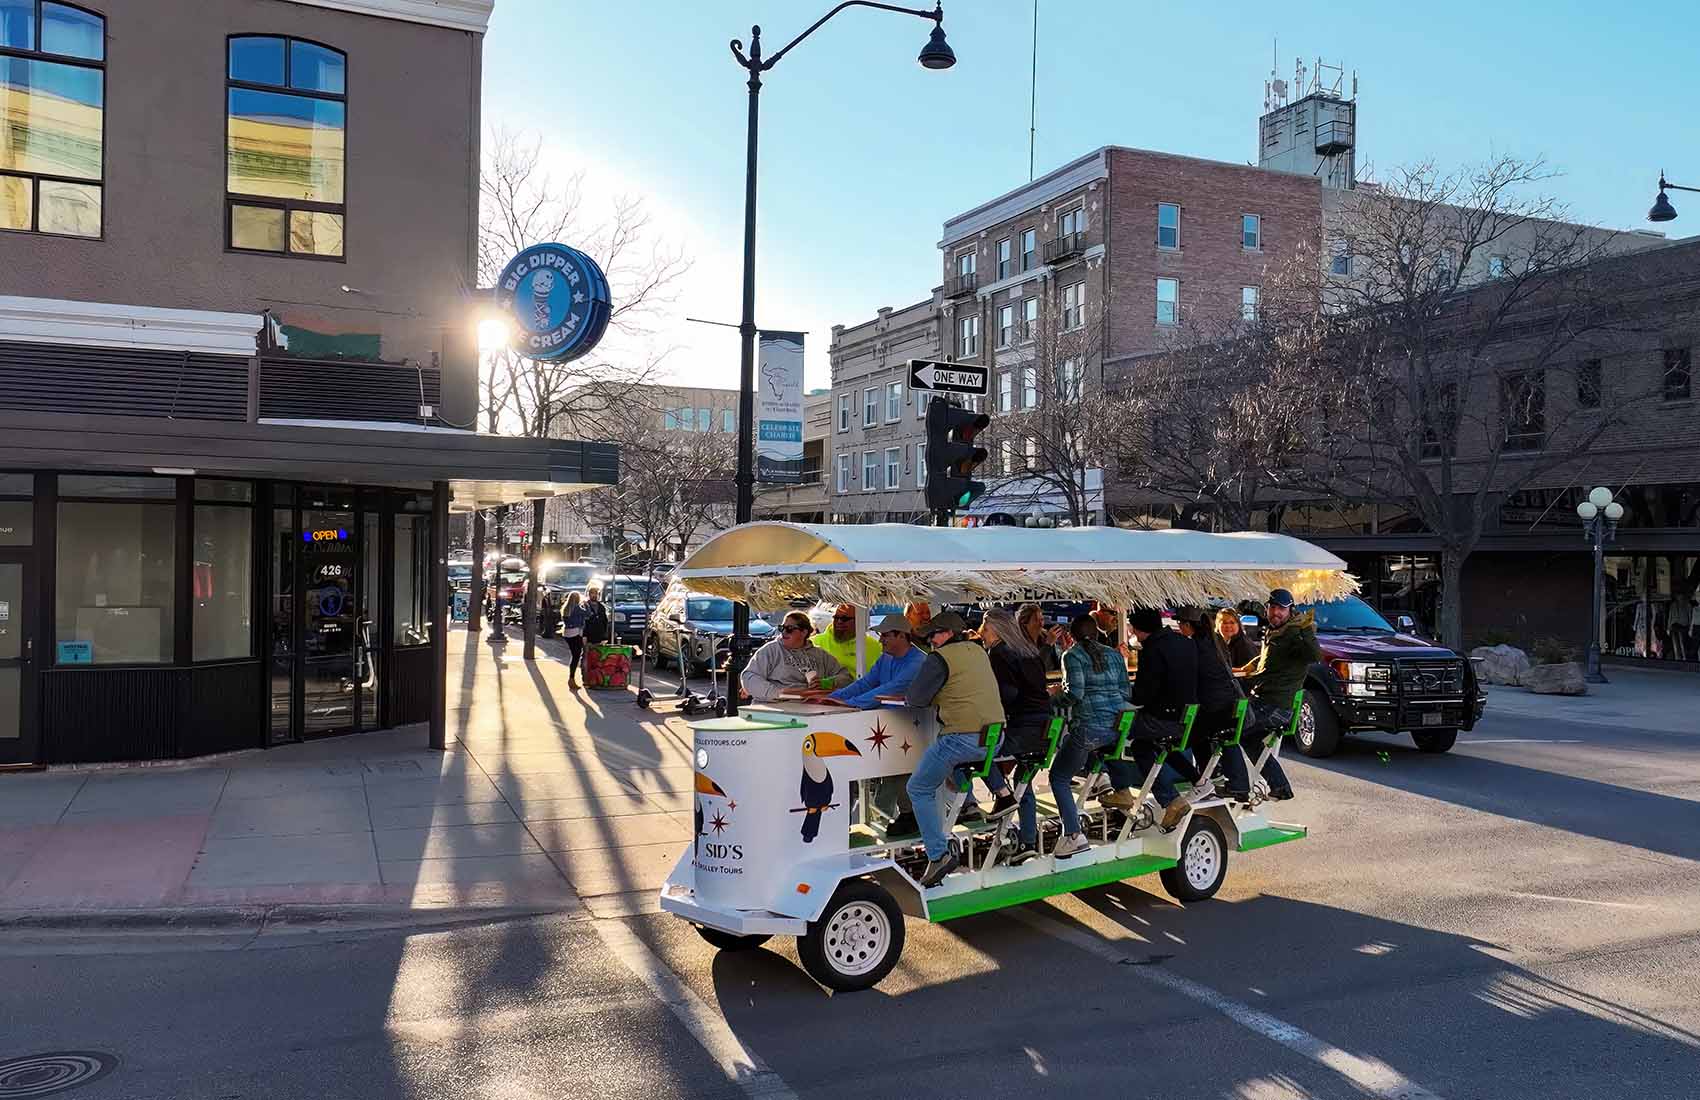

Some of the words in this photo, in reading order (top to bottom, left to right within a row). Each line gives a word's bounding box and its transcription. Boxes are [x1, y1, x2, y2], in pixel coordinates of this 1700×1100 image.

[505, 263, 528, 291] BIG
[529, 253, 581, 287] DIPPER
[530, 313, 580, 347] CREAM
[934, 370, 955, 384] ONE
[958, 373, 980, 386] WAY
[313, 530, 337, 541] OPEN
[320, 564, 342, 576] 426
[705, 842, 744, 861] SID'S
